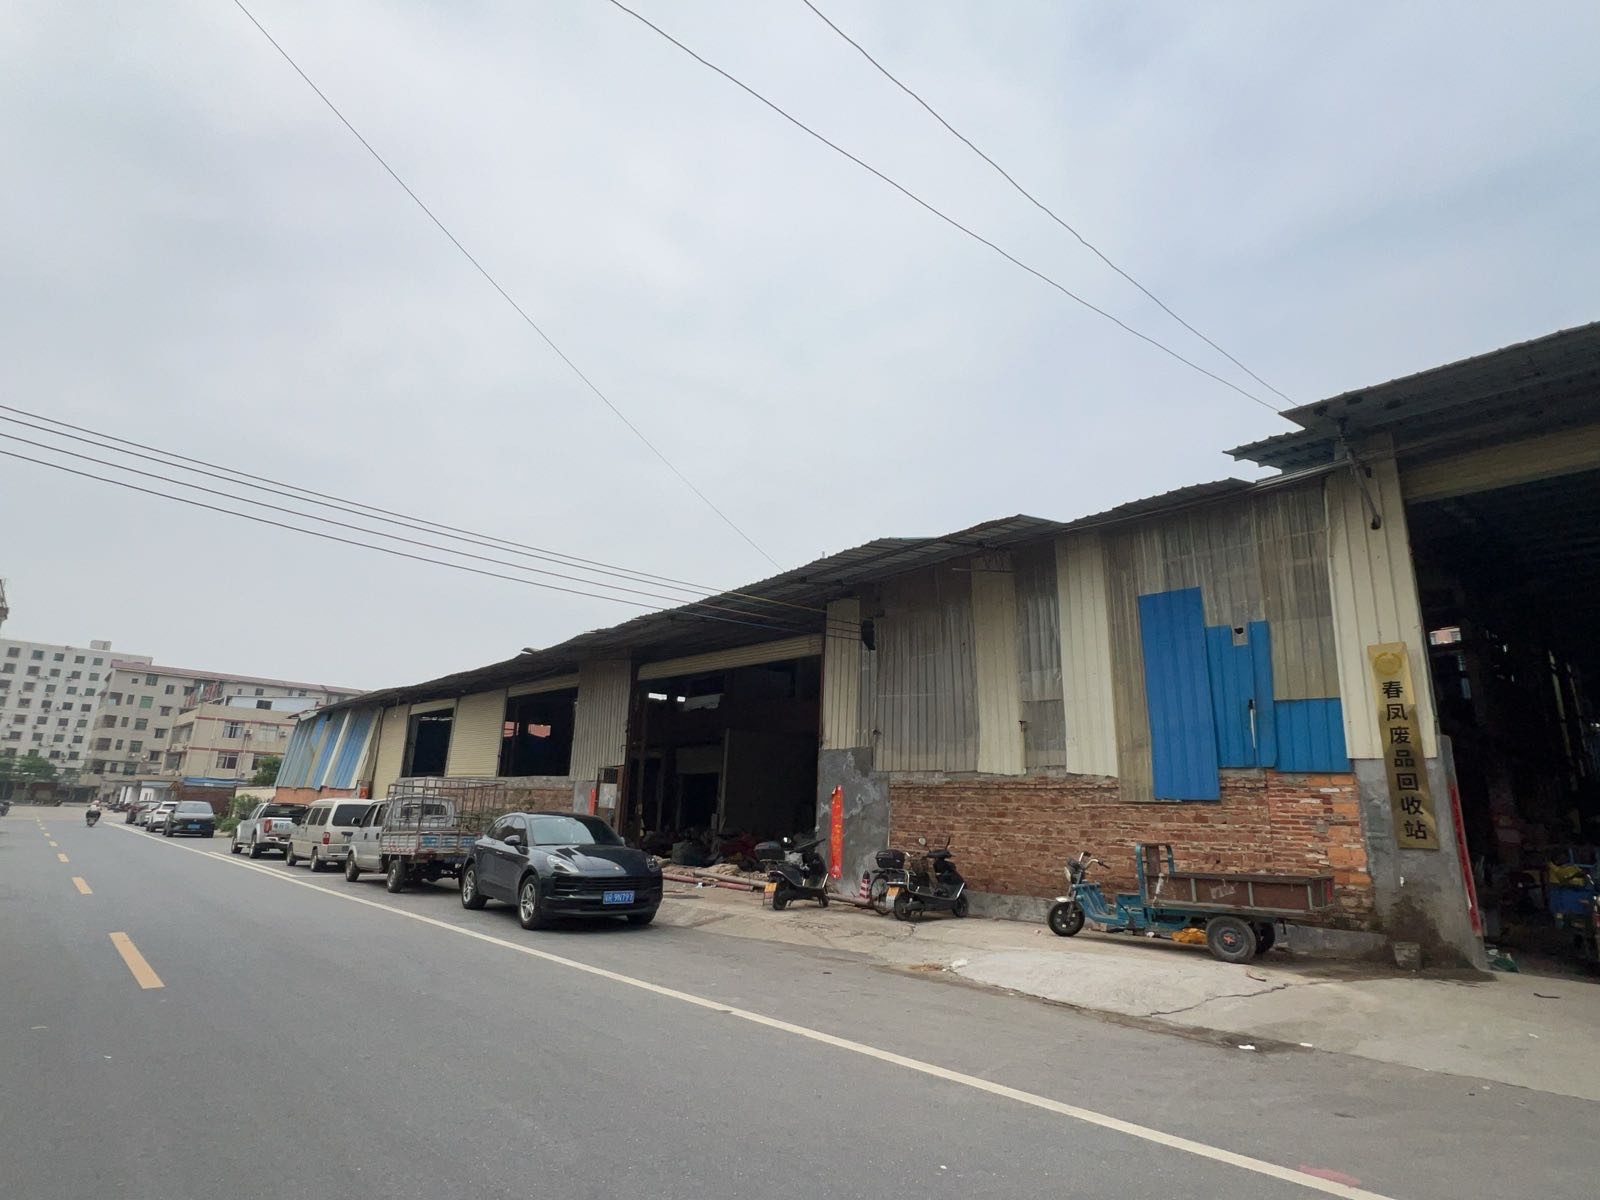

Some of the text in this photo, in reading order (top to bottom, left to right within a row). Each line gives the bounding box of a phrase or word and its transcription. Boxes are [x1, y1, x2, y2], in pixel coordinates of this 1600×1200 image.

[1382, 681, 1427, 840] 春凤废品回收站
